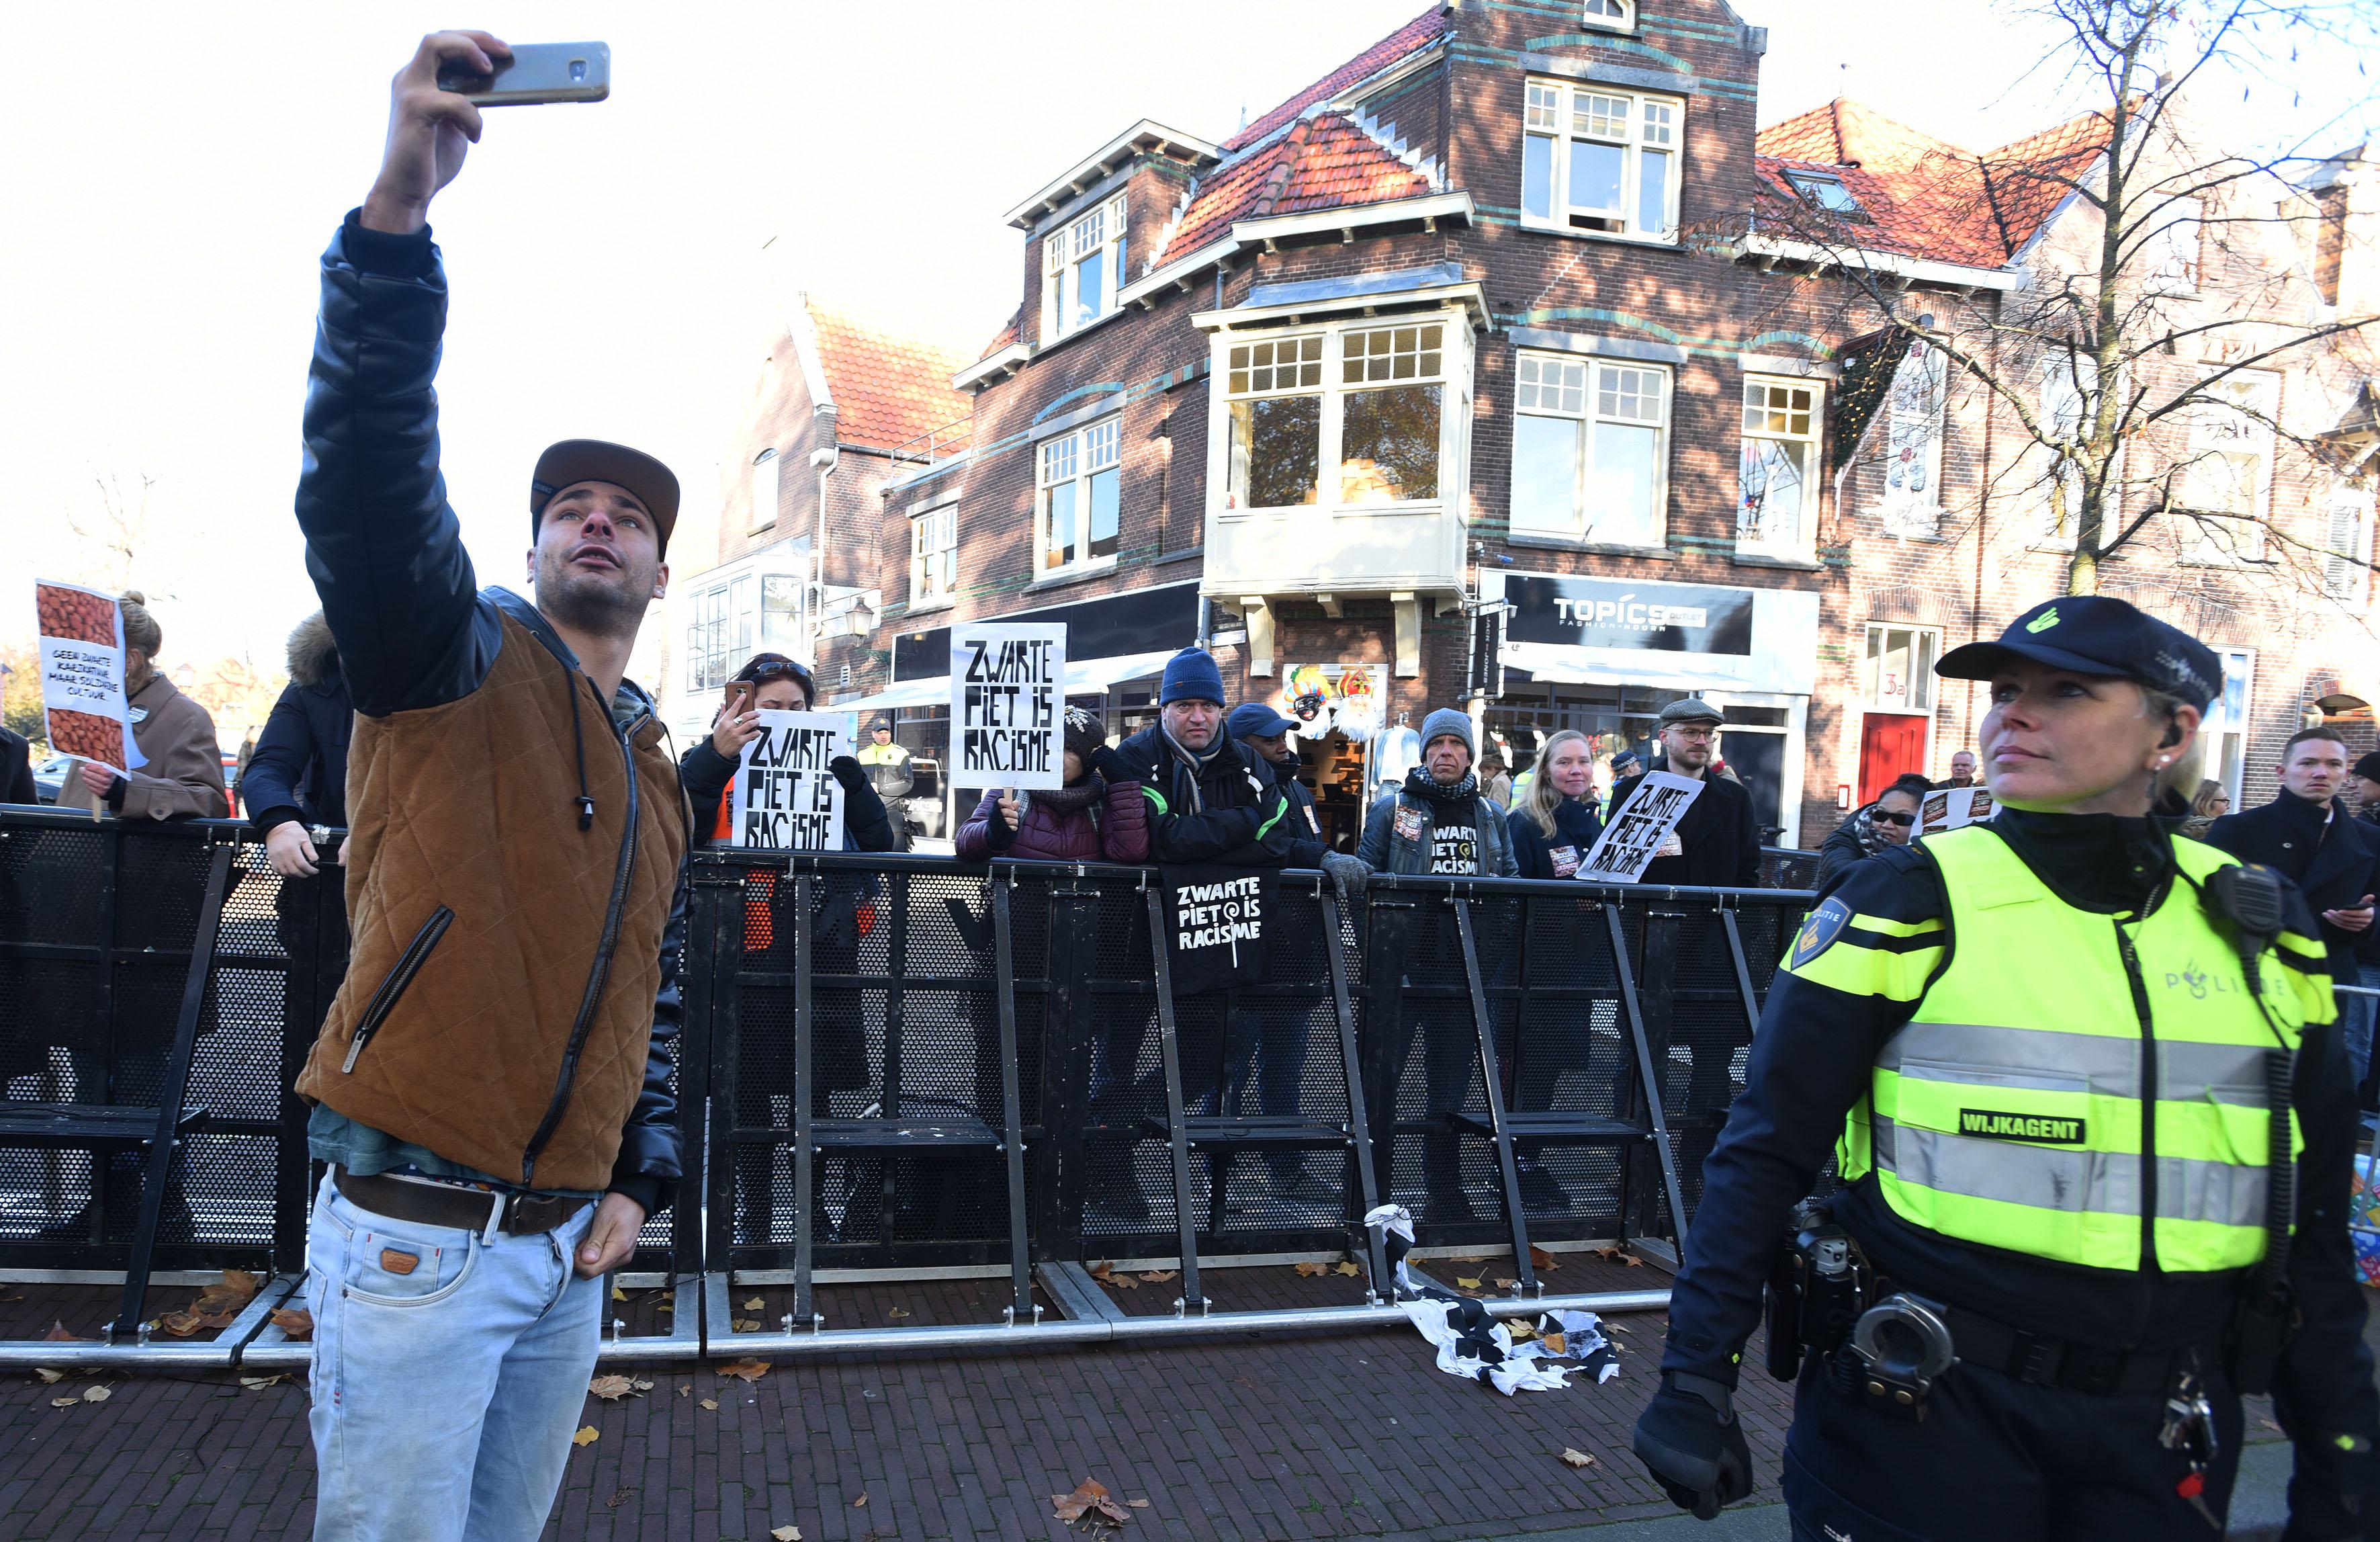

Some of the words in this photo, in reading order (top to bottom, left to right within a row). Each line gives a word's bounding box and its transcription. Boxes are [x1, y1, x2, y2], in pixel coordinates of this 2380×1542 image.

[1669, 611, 1702, 622] OUTLET
[965, 640, 1053, 683] ZWARTE
[1884, 673, 1906, 695] 3a
[749, 726, 836, 771] ZWARTE
[1626, 784, 1689, 820] ZWARTE
[1433, 826, 1477, 841] WART
[1177, 877, 1260, 905] ZWARTE
[1962, 1113, 2080, 1140] WIJKAGENT
